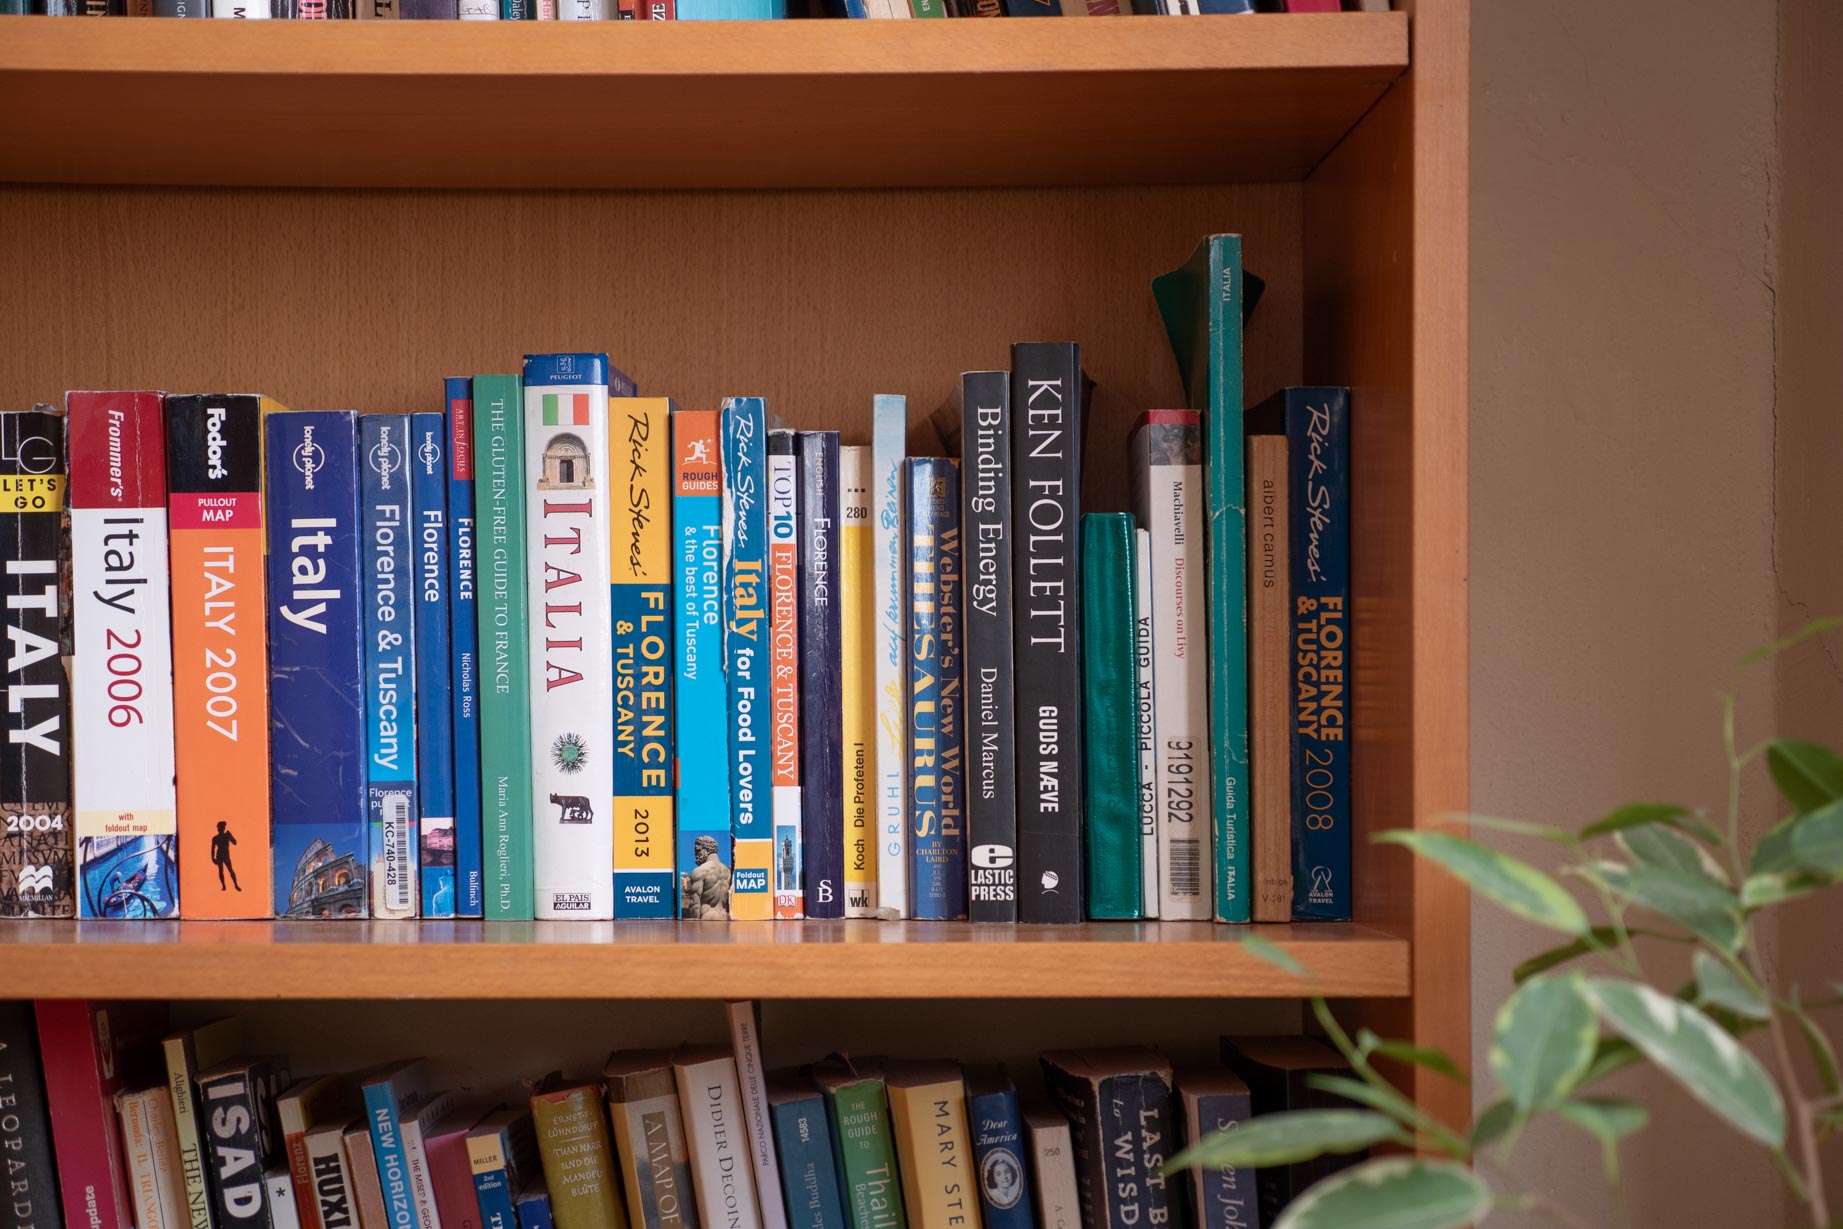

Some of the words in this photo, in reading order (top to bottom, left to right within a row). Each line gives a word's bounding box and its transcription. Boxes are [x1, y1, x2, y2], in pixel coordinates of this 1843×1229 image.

[1222, 267, 1231, 302] ITALIA
[491, 398, 504, 432] THE
[1028, 377, 1063, 460] KEN
[108, 409, 125, 498] Frommer's
[206, 408, 228, 480] Fodor's
[301, 425, 315, 458] lonely
[378, 426, 391, 458] lonely
[627, 412, 650, 482] Rick
[735, 413, 753, 472] Rick
[971, 405, 1003, 513] Binding
[1306, 402, 1331, 480] Rick
[3, 478, 57, 492] LET'S
[301, 458, 315, 490] planet
[378, 458, 391, 490] planet
[491, 436, 509, 545] GLUTEN-FREE
[682, 472, 718, 481] ROUGH
[682, 481, 718, 490] GUIDES
[14, 495, 47, 509] GO
[198, 498, 238, 507] PULLOUT
[202, 509, 234, 522] MAP
[846, 507, 868, 519] 280
[1173, 481, 1185, 546] Machiavelli
[685, 527, 696, 536] &
[686, 539, 698, 562] the
[93, 517, 148, 615] Italy
[279, 517, 341, 635] Italy
[375, 505, 400, 622] Florence
[423, 510, 443, 602] Florence
[458, 518, 473, 601] FLORENCE
[493, 548, 508, 600] GUIDE
[702, 525, 722, 625] Florence
[814, 518, 831, 606] FLORENCE
[972, 521, 1003, 617] Energy
[1028, 478, 1065, 653] FOLLETT
[1263, 532, 1274, 588] camus
[203, 546, 236, 636] ITALY
[543, 498, 593, 692] ITALIA
[685, 567, 698, 598] best
[729, 558, 765, 642] Italy
[939, 527, 960, 669] Webster's
[1174, 558, 1185, 618] Discourses
[494, 602, 508, 629] TO
[686, 602, 699, 617] of
[775, 551, 793, 661] FLORENCE
[1176, 619, 1184, 634] on
[1297, 595, 1318, 616] &
[377, 629, 402, 652] &
[616, 620, 634, 635] &
[1138, 616, 1150, 668] GUIDA
[1174, 635, 1187, 660] Livy
[6, 560, 60, 756] ITALY
[496, 630, 509, 694] FRANCE
[683, 619, 699, 680] Tuscany
[737, 647, 754, 680] for
[1319, 596, 1344, 741] FLORENCE
[107, 628, 144, 728] 2006
[461, 652, 471, 693] Nicholas
[640, 591, 665, 787] FLORENCE
[776, 664, 793, 680] &
[913, 524, 937, 838] THESAURUS
[1297, 619, 1318, 740] TUSCANY
[204, 647, 238, 742] 2007
[374, 656, 403, 771] Tuscany
[462, 694, 472, 718] Ross
[616, 643, 635, 758] TUSCANY
[737, 687, 756, 742] Food
[940, 676, 960, 738] New
[980, 667, 998, 727] Daniel
[1139, 680, 1152, 751] PICCOLA
[776, 683, 794, 780] TUSCANY
[1038, 705, 1058, 755] GUDS
[853, 749, 865, 805] Profeten
[981, 732, 999, 799] Marcus
[1167, 740, 1193, 823] 9191292
[498, 776, 508, 808] Maria
[738, 749, 756, 825] Lovers
[941, 745, 960, 837] World
[1039, 761, 1060, 813] NÆVE
[1140, 780, 1154, 836] LUCCA
[1225, 777, 1236, 809] Guida
[1305, 748, 1334, 830] 2008
[7, 814, 64, 832] 2004
[105, 823, 131, 833] foldout
[132, 823, 148, 834] map
[118, 812, 135, 822] with
[498, 809, 508, 832] Ann
[634, 808, 650, 858] 2013
[853, 806, 865, 828] Die
[887, 771, 901, 856] GRUHL
[385, 821, 397, 886] KC-740-428
[853, 839, 865, 871] Koch
[1226, 812, 1237, 860] Turistica
[469, 871, 479, 907] Bulfinch
[624, 885, 660, 893] AVALON
[736, 871, 765, 879] Foldout
[736, 879, 765, 889] MAP
[971, 869, 1014, 885] LASTIC
[971, 885, 1014, 901] PRESS
[1227, 866, 1236, 901] ITALIA
[555, 902, 590, 910] AGUILAR
[625, 895, 660, 904] TRAVEL
[778, 895, 796, 907] DK
[849, 890, 868, 907] wk
[739, 1022, 749, 1040] TERRE
[743, 1040, 754, 1077] CINQUE
[173, 1072, 189, 1114] Alighieri
[748, 1077, 759, 1096] DELLE
[851, 1101, 865, 1111] THE
[375, 1106, 396, 1149] NEW
[645, 1119, 663, 1136] A
[707, 1084, 729, 1152] DIDIER
[843, 1111, 878, 1126] ROUGH
[982, 1119, 1008, 1131] Dear
[1112, 1098, 1125, 1118] to
[206, 1081, 263, 1219] ISAD
[798, 1117, 810, 1143] 14583
[847, 1126, 878, 1138] GUIDE
[859, 1141, 870, 1150] TO
[933, 1099, 958, 1169] MARY
[976, 1132, 1018, 1146] America
[1140, 1107, 1166, 1190] LAST
[182, 1143, 204, 1187] THE
[410, 1158, 421, 1173] THE
[472, 1155, 498, 1167] MILLER
[648, 1140, 674, 1190] MAP
[1044, 1148, 1061, 1157] 250
[478, 1181, 502, 1191] edition
[483, 1175, 495, 1183] 2nd
[804, 1162, 821, 1209] Buddha
[659, 1193, 681, 1225] OF
